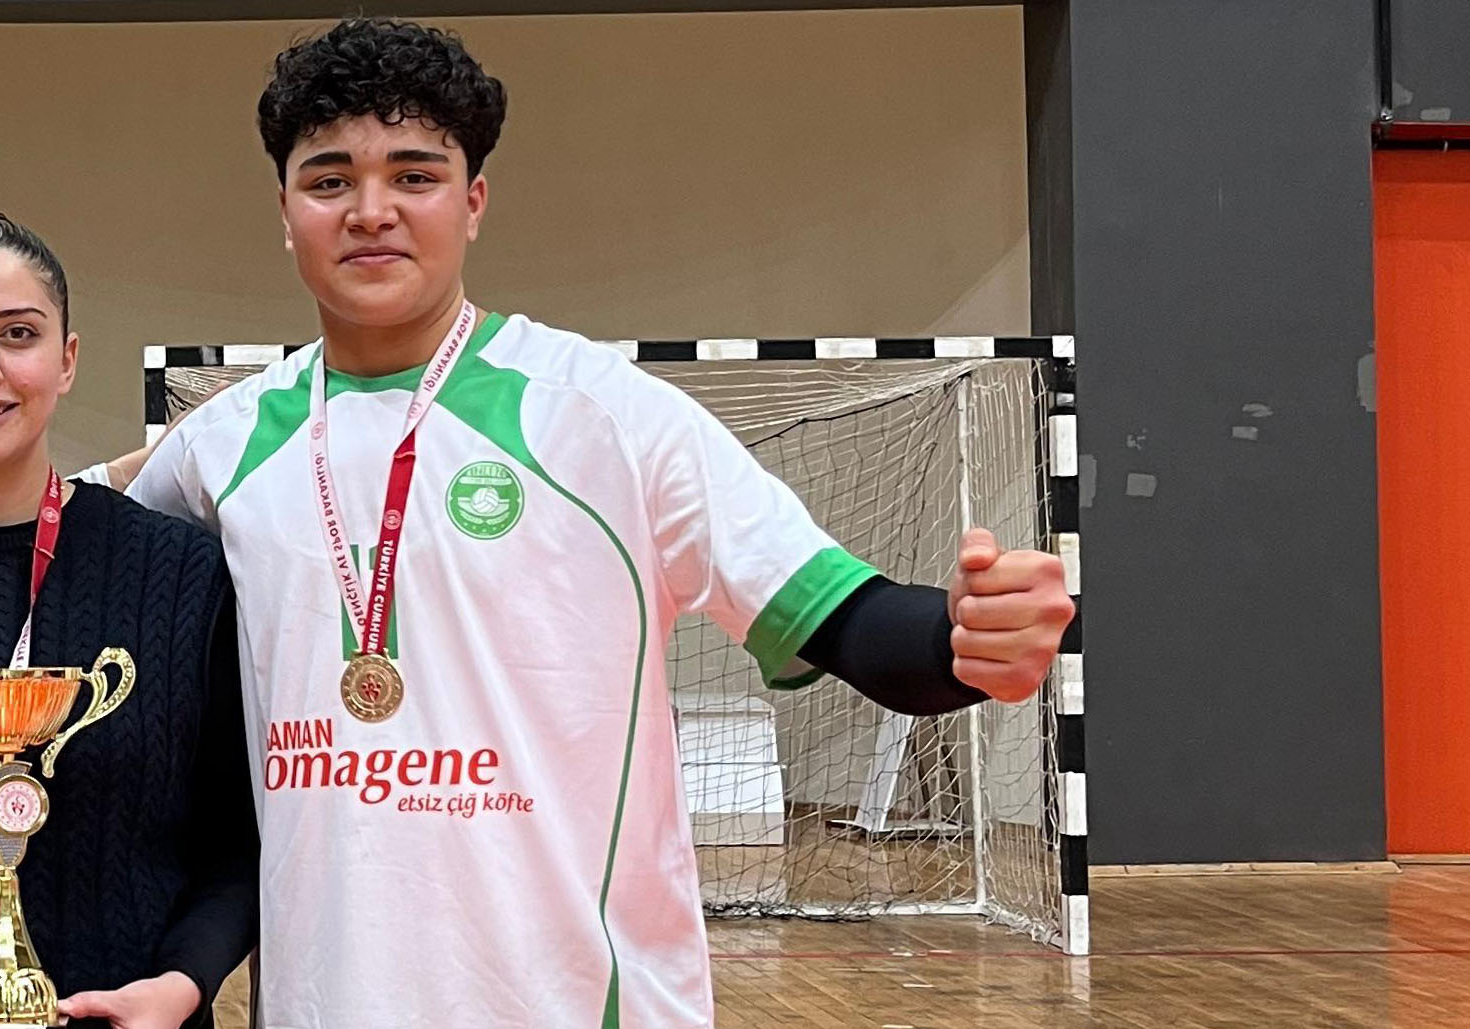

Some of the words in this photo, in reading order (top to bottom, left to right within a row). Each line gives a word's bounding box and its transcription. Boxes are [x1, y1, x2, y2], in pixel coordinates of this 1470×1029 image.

[375, 539, 395, 592] TÜRKİYE
[366, 594, 385, 654] CUMHUR
[267, 718, 333, 751] AMAN
[265, 748, 499, 804] omagene
[397, 794, 443, 812] etsiz
[447, 792, 477, 819] çiğ
[482, 792, 535, 814] köfte
